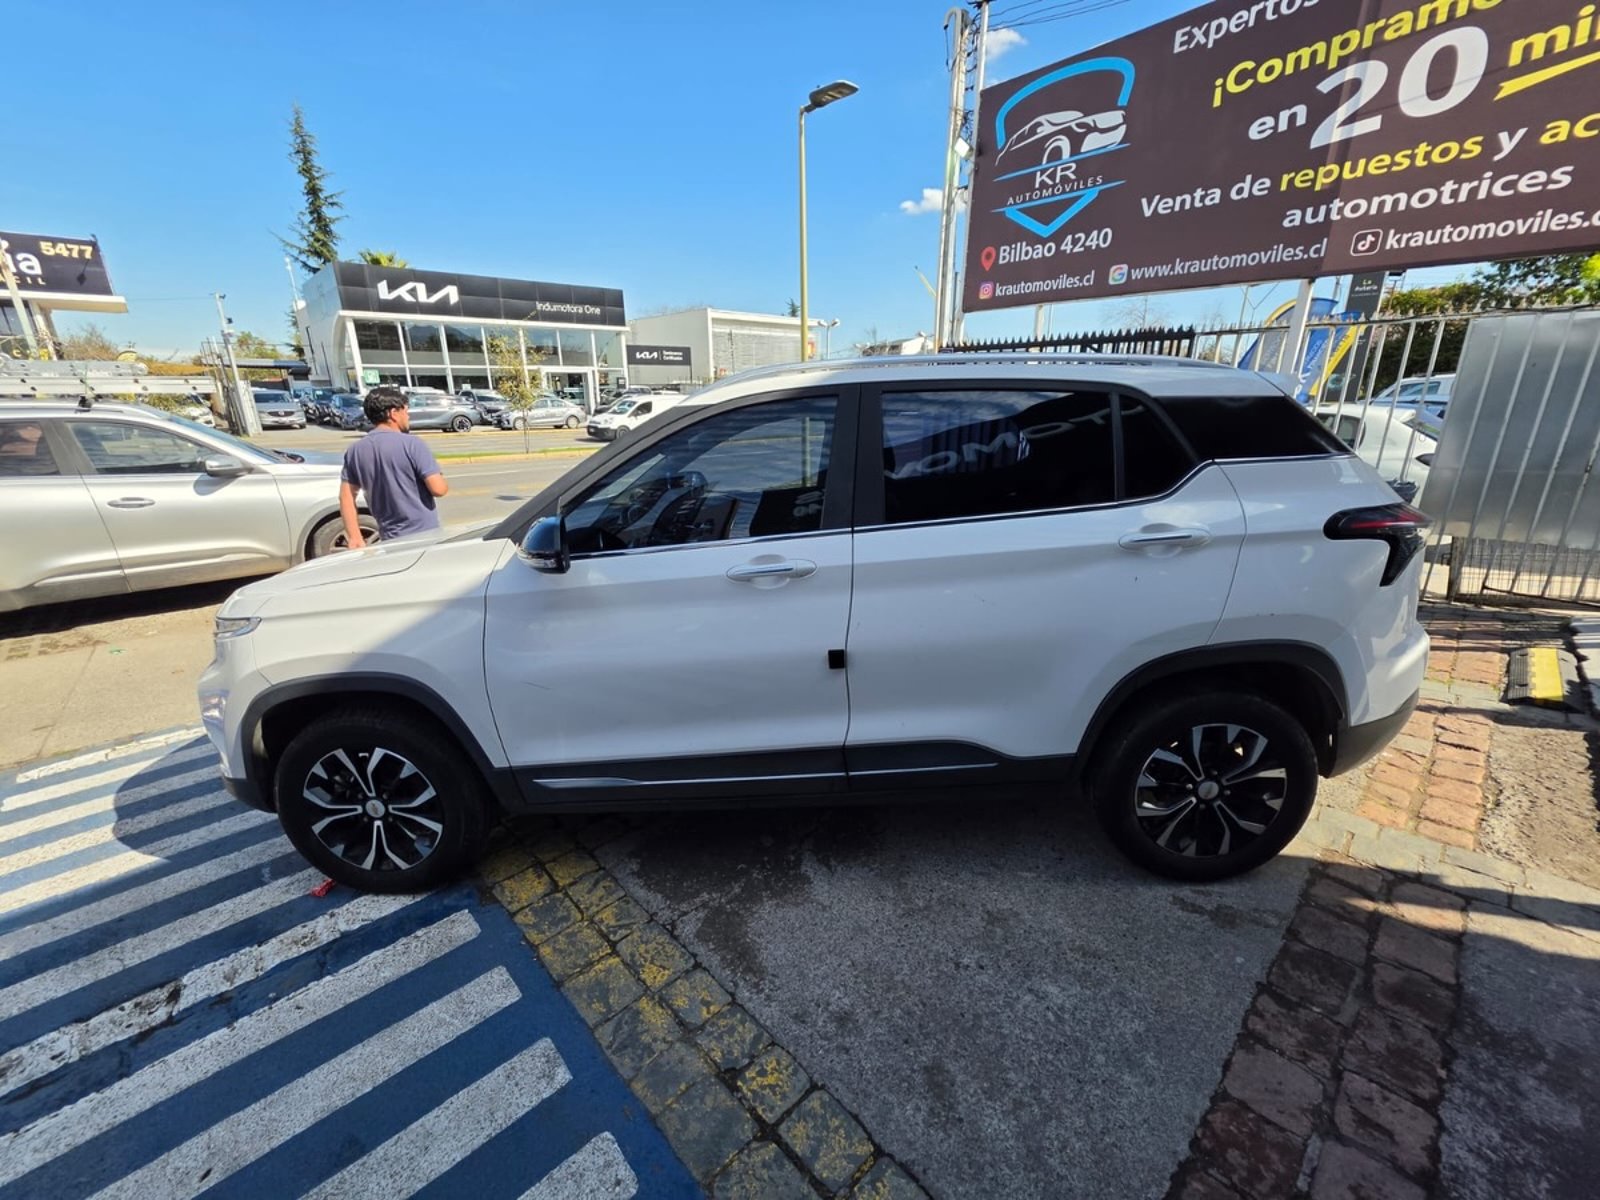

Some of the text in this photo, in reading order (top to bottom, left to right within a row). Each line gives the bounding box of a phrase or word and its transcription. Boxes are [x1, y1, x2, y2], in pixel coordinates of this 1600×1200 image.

[1248, 4, 1600, 149] en 20 mi
[1035, 162, 1077, 189] KR
[1140, 187, 1222, 217] Venta
[1229, 174, 1272, 200] de
[1280, 135, 1485, 191] repuestos
[1492, 127, 1529, 162] y
[1007, 175, 1104, 206] AUTOMÓVILES
[1282, 165, 1575, 228] automotrices
[39, 240, 94, 260] 5477
[998, 227, 1113, 265] Bilbao 4240
[1130, 237, 1329, 280] www.krautomoviles.cl
[377, 279, 460, 305] KIA
[995, 269, 1096, 297] krautomoviles.cl
[535, 301, 601, 315] Indumotora One
